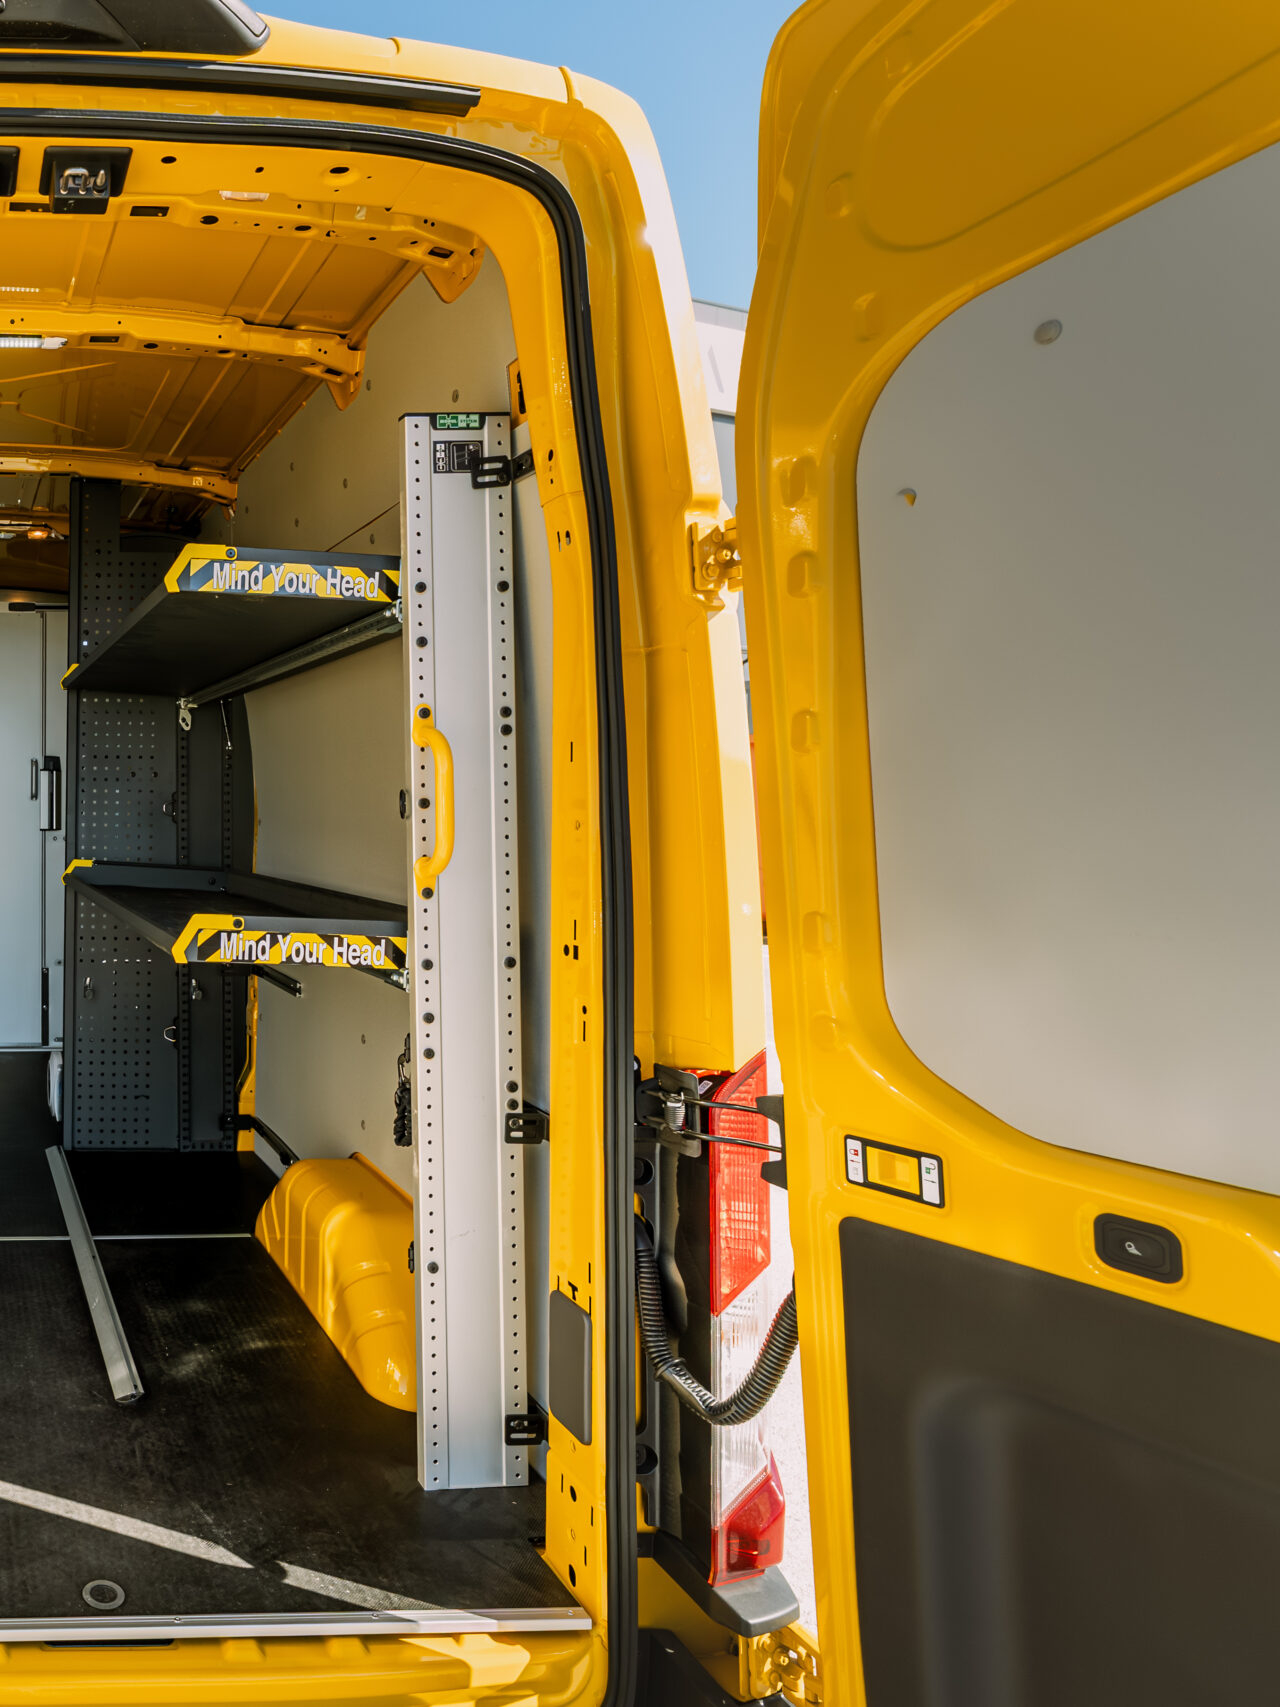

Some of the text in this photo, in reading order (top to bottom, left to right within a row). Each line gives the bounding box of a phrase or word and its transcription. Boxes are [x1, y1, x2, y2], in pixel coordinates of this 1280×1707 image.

[213, 562, 380, 598] Mind Your Head
[220, 932, 386, 967] Mind Your Head
